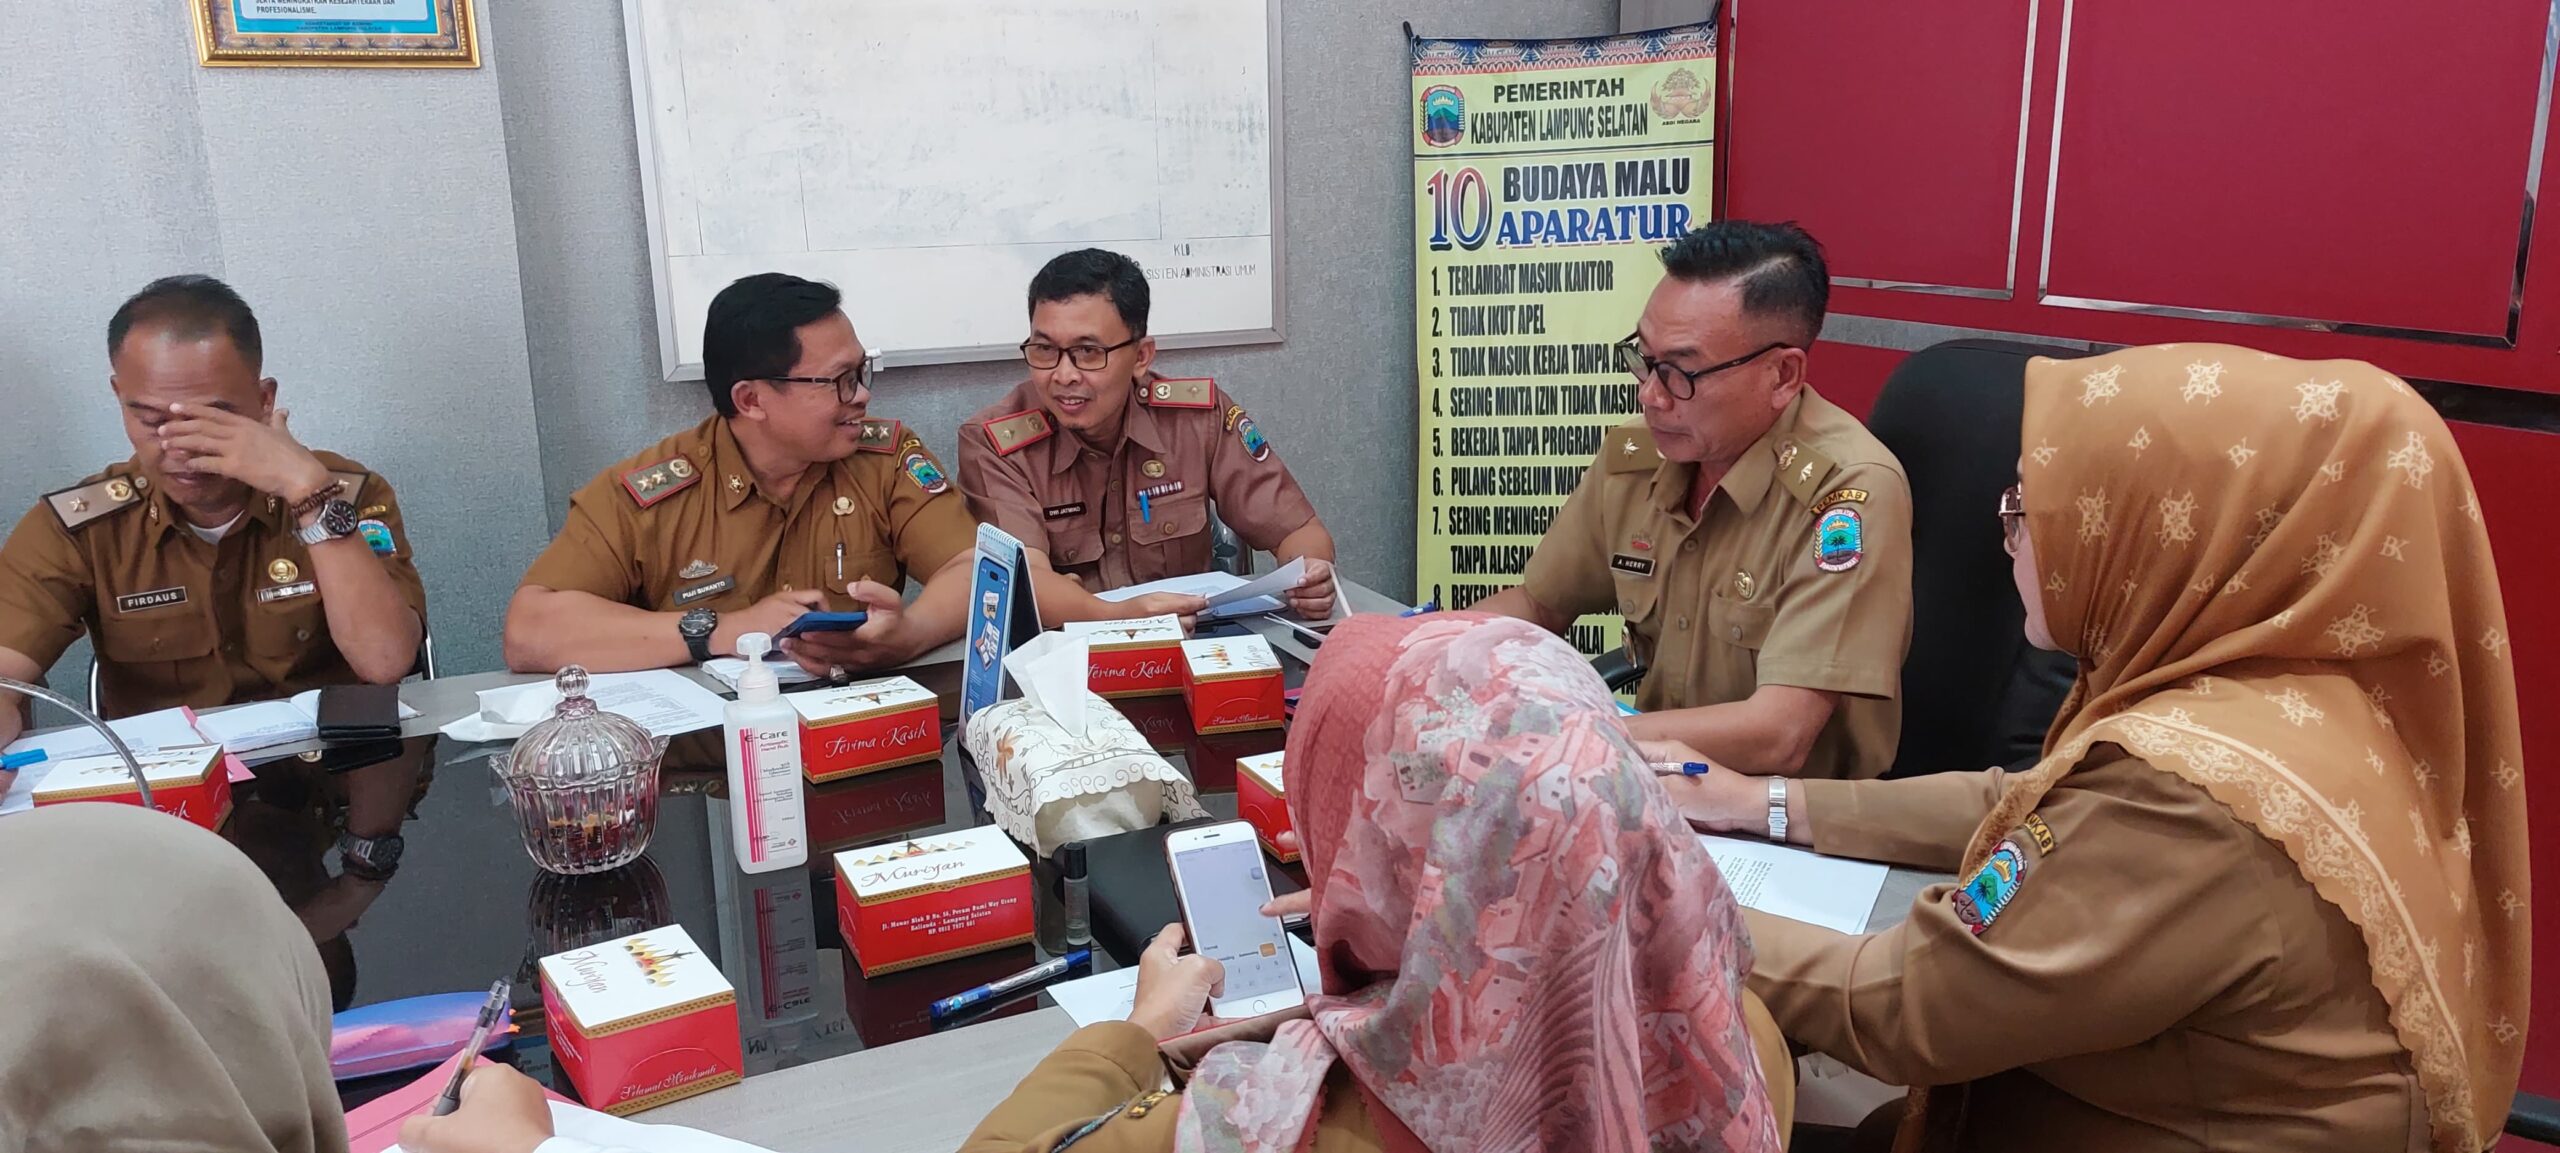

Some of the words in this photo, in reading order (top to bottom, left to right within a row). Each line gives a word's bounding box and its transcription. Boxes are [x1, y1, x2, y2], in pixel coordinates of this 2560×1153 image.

[1494, 78, 1625, 104] PEMERINTAH
[1470, 110, 1537, 145] KABUPATEN
[1540, 107, 1594, 141] LAMPUNG
[1597, 103, 1649, 138] SELATAN
[1503, 162, 1608, 203] BUDAYA
[1615, 158, 1691, 198] MALU
[1426, 167, 1492, 251] 10
[1496, 203, 1693, 249] APARATUR
[1146, 266, 1178, 280] SISTEN
[1180, 264, 1232, 279] ADMINISTRASI
[1235, 263, 1256, 278] UMUM
[1431, 269, 1441, 297] 1.
[1448, 264, 1516, 296] TERLAMBAT
[1519, 262, 1563, 295] MASUK
[1564, 260, 1614, 293] KANTOR
[1431, 307, 1442, 337] 2.
[1450, 306, 1486, 337] TIDAK
[1488, 305, 1516, 335] IKUT
[1519, 303, 1546, 334] APEL
[1432, 349, 1443, 378] 3.
[1450, 346, 1486, 377] TIDAK
[1488, 345, 1532, 377] MASUK
[1533, 344, 1569, 376] KERJA
[1571, 343, 1610, 374] TANPA
[1432, 387, 1443, 417] 4.
[1450, 386, 1493, 417] SERING
[1494, 385, 1534, 416] MINTA
[1534, 385, 1559, 415] IZIN
[1560, 384, 1597, 415] TIDAK
[1432, 427, 1443, 457] 5.
[1451, 427, 1500, 456] BEKERJA
[1502, 426, 1540, 456] TANPA
[1542, 425, 1602, 456] PROGRAM
[1432, 467, 1443, 496] 6.
[1451, 467, 1496, 496] PULANG
[1499, 466, 1551, 496] SEBELUM
[1816, 491, 1863, 511] PEMKAB
[1432, 506, 1442, 535] 7.
[1449, 506, 1491, 536] SERING
[1450, 545, 1487, 574] TANPA
[127, 592, 178, 607] FIRDAUS
[1566, 625, 1605, 654] KALAI
[1130, 658, 1174, 679] Kasih
[825, 736, 877, 759] Terima
[881, 720, 927, 749] Kasih
